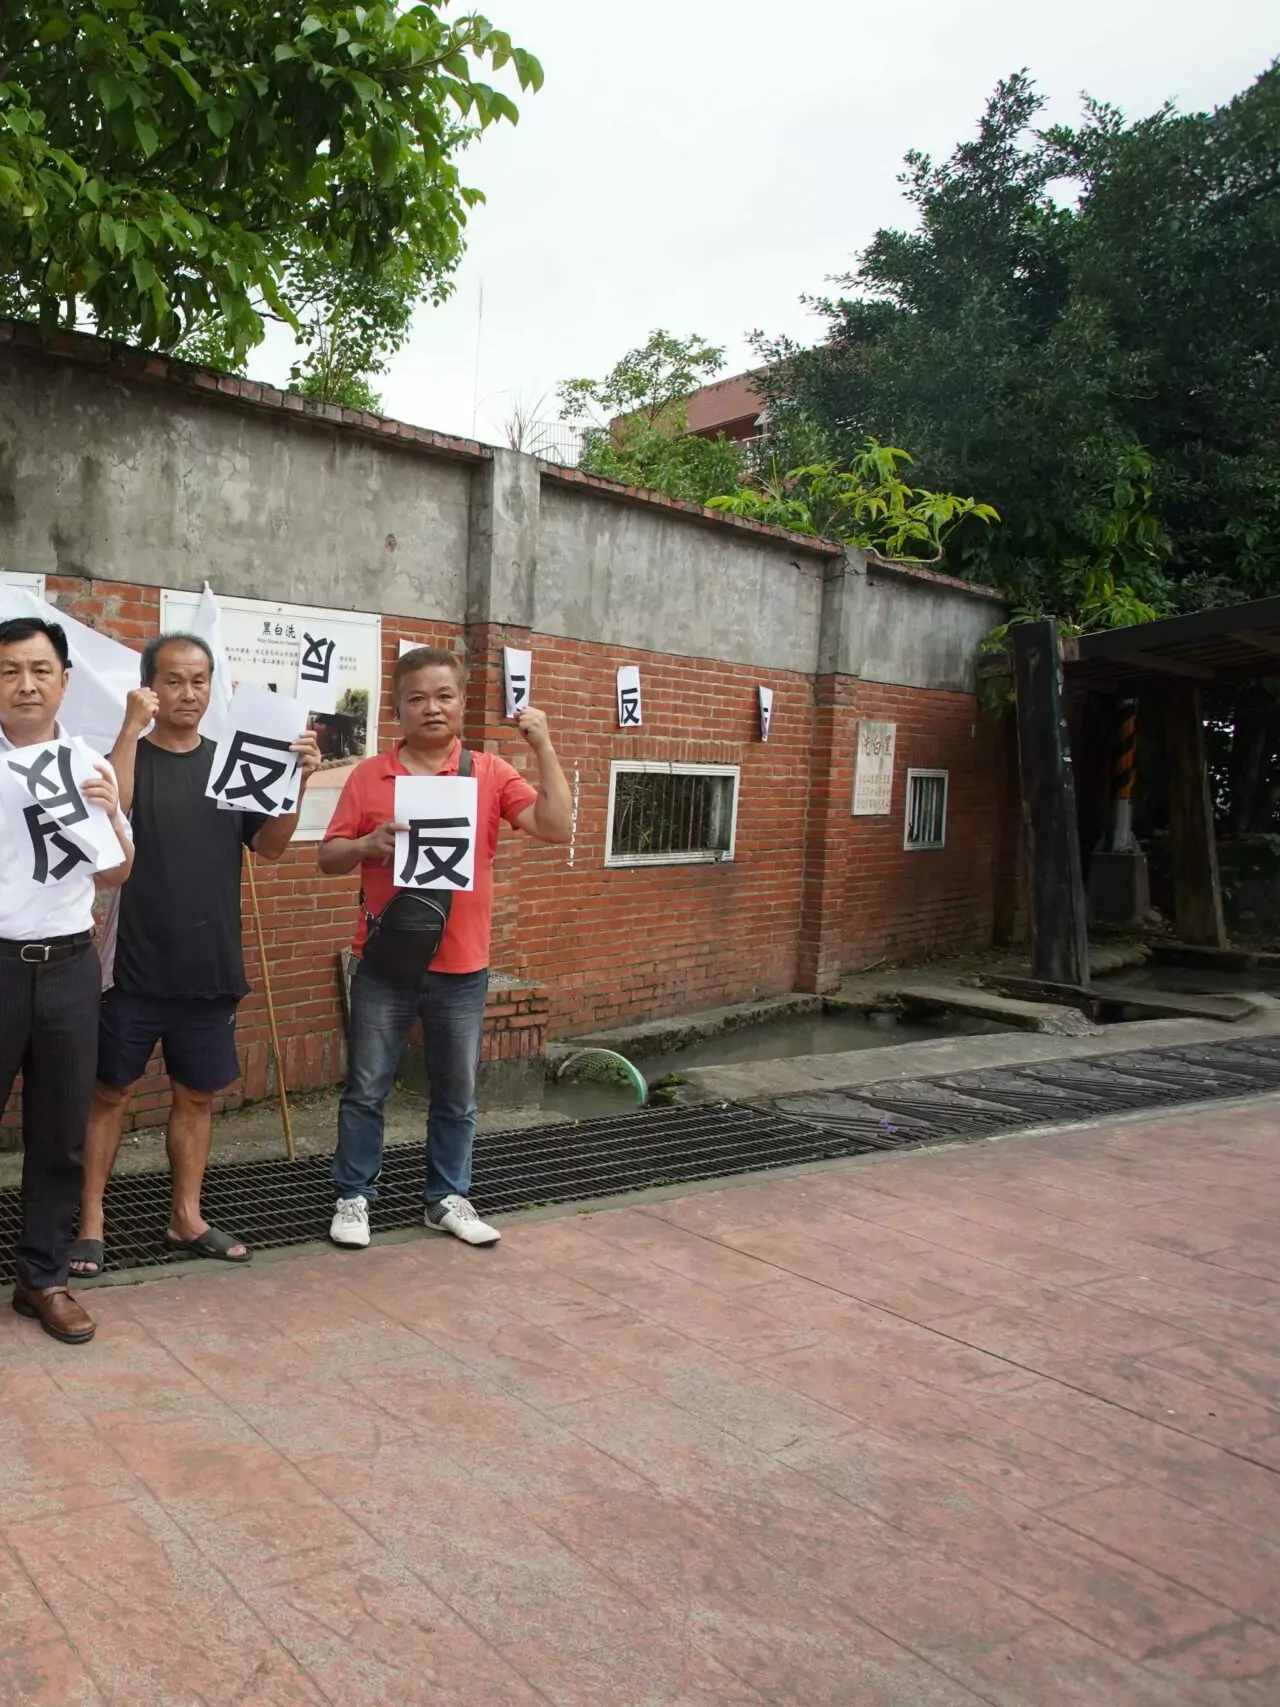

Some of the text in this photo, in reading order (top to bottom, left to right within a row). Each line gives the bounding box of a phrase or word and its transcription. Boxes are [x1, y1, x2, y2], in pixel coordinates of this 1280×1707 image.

[262, 621, 296, 639] 黑白洗
[301, 632, 336, 683] 反
[621, 687, 640, 725] 反
[212, 730, 293, 812] 反
[400, 817, 471, 888] 反
